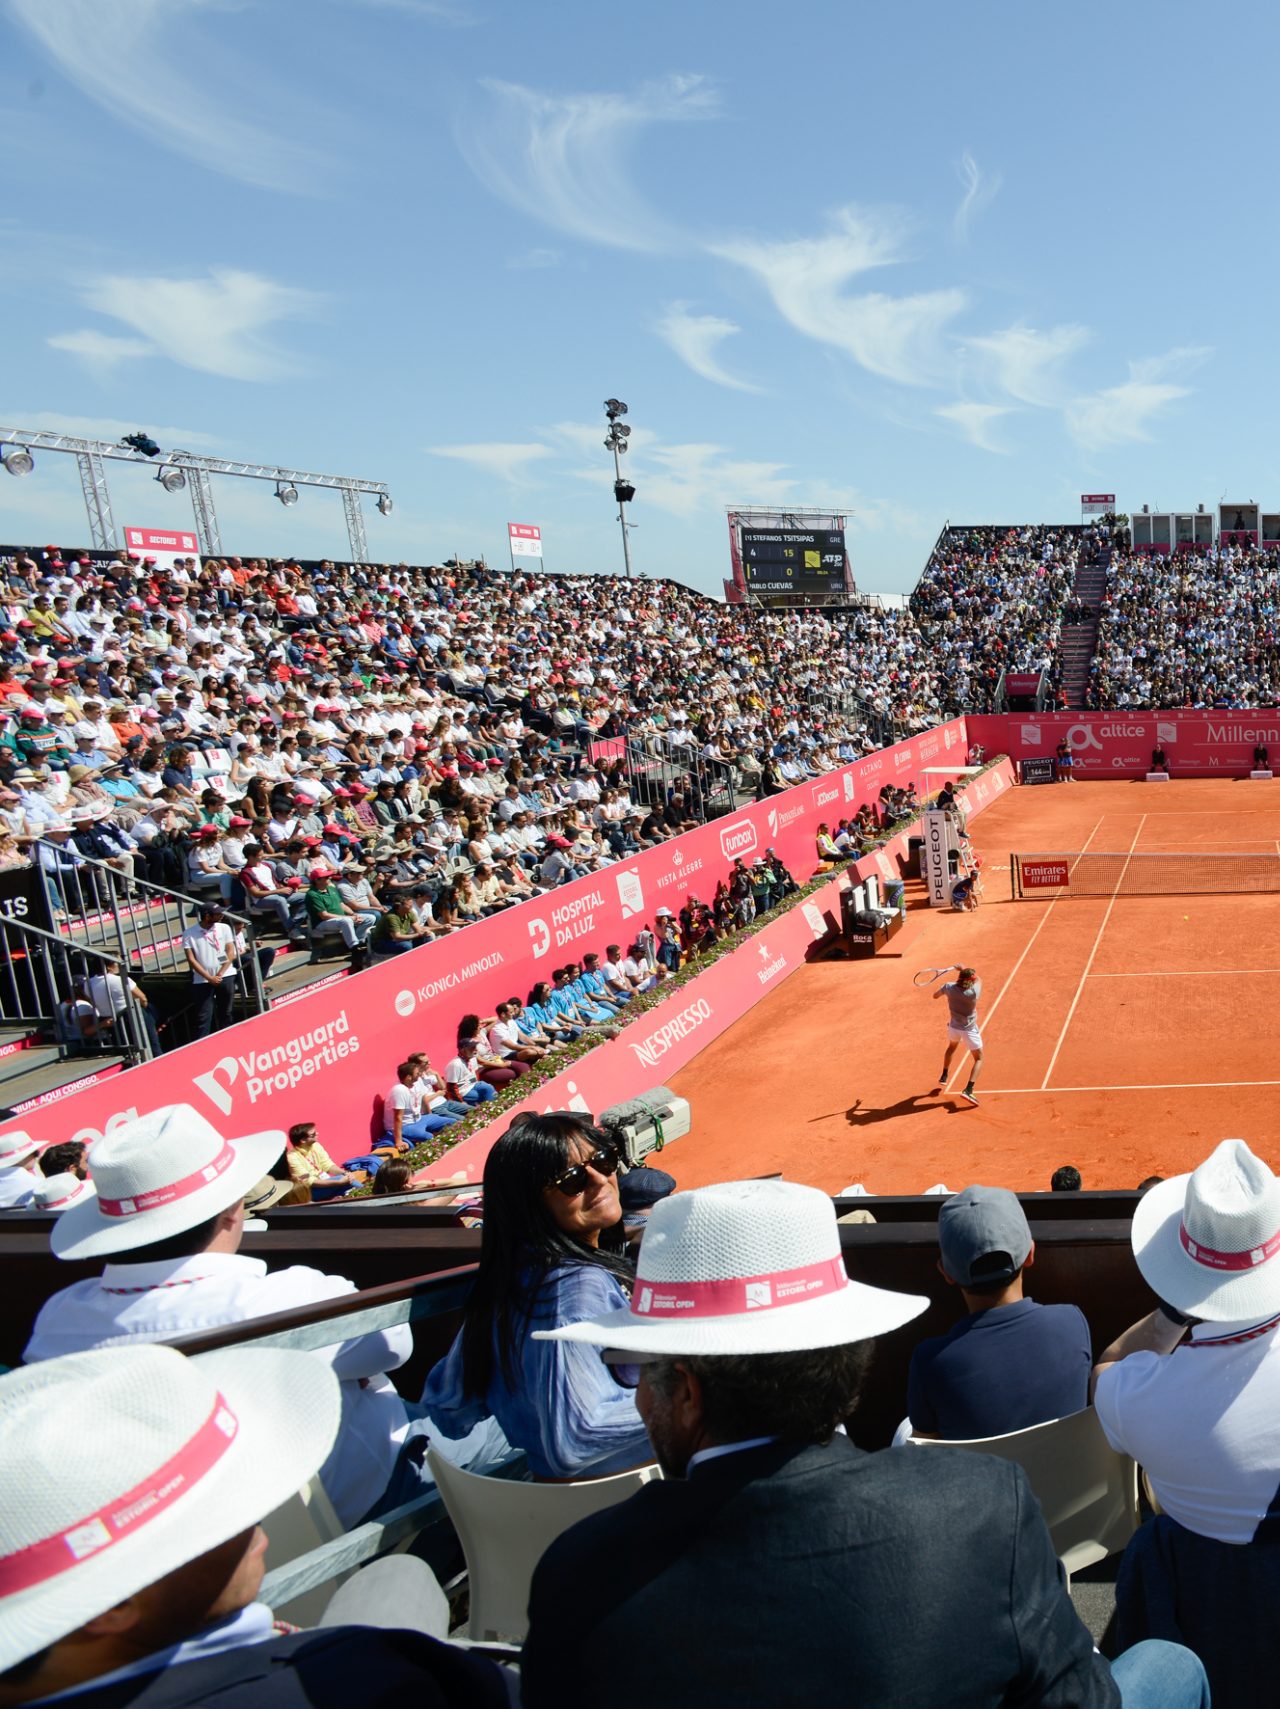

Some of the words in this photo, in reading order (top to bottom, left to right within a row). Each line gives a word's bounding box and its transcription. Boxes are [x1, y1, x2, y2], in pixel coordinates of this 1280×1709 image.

[149, 535, 177, 546] SECTORES
[753, 534, 782, 542] STEFANOS
[783, 534, 815, 543] TSITSIPAS
[750, 548, 756, 557] 4
[783, 548, 794, 557] 15
[822, 554, 842, 563] ATP
[751, 567, 757, 576] 1
[786, 568, 793, 576] 0
[1100, 724, 1145, 738] altice
[1023, 758, 1054, 766] PEUGEOT
[817, 787, 840, 807] JCDecaux
[726, 828, 753, 852] funbox
[930, 818, 944, 900] PEUGEOT
[656, 871, 677, 889] VISTA
[678, 858, 703, 882] ALEGRE
[1024, 865, 1067, 877] Emirates
[1031, 876, 1041, 884] FLY
[1040, 875, 1061, 884] BETTER
[552, 890, 605, 928] HOSPITAL
[555, 929, 574, 948] DA
[574, 914, 596, 939] LUZ
[417, 974, 460, 1002] KONICA
[461, 951, 504, 981] MINOLTA
[757, 953, 788, 984] Heineken
[628, 998, 710, 1068] NESPRESSO
[238, 1010, 349, 1077] Vanguard
[246, 1035, 360, 1104] Properties
[40, 1088, 62, 1104] AQUI
[62, 1075, 100, 1095] CONSIGO.
[776, 1279, 807, 1290] Millennium
[776, 1286, 806, 1298] ESTORIL
[807, 1279, 824, 1291] OPEN
[676, 1300, 696, 1308] OPEN
[157, 1474, 186, 1499] OPEN
